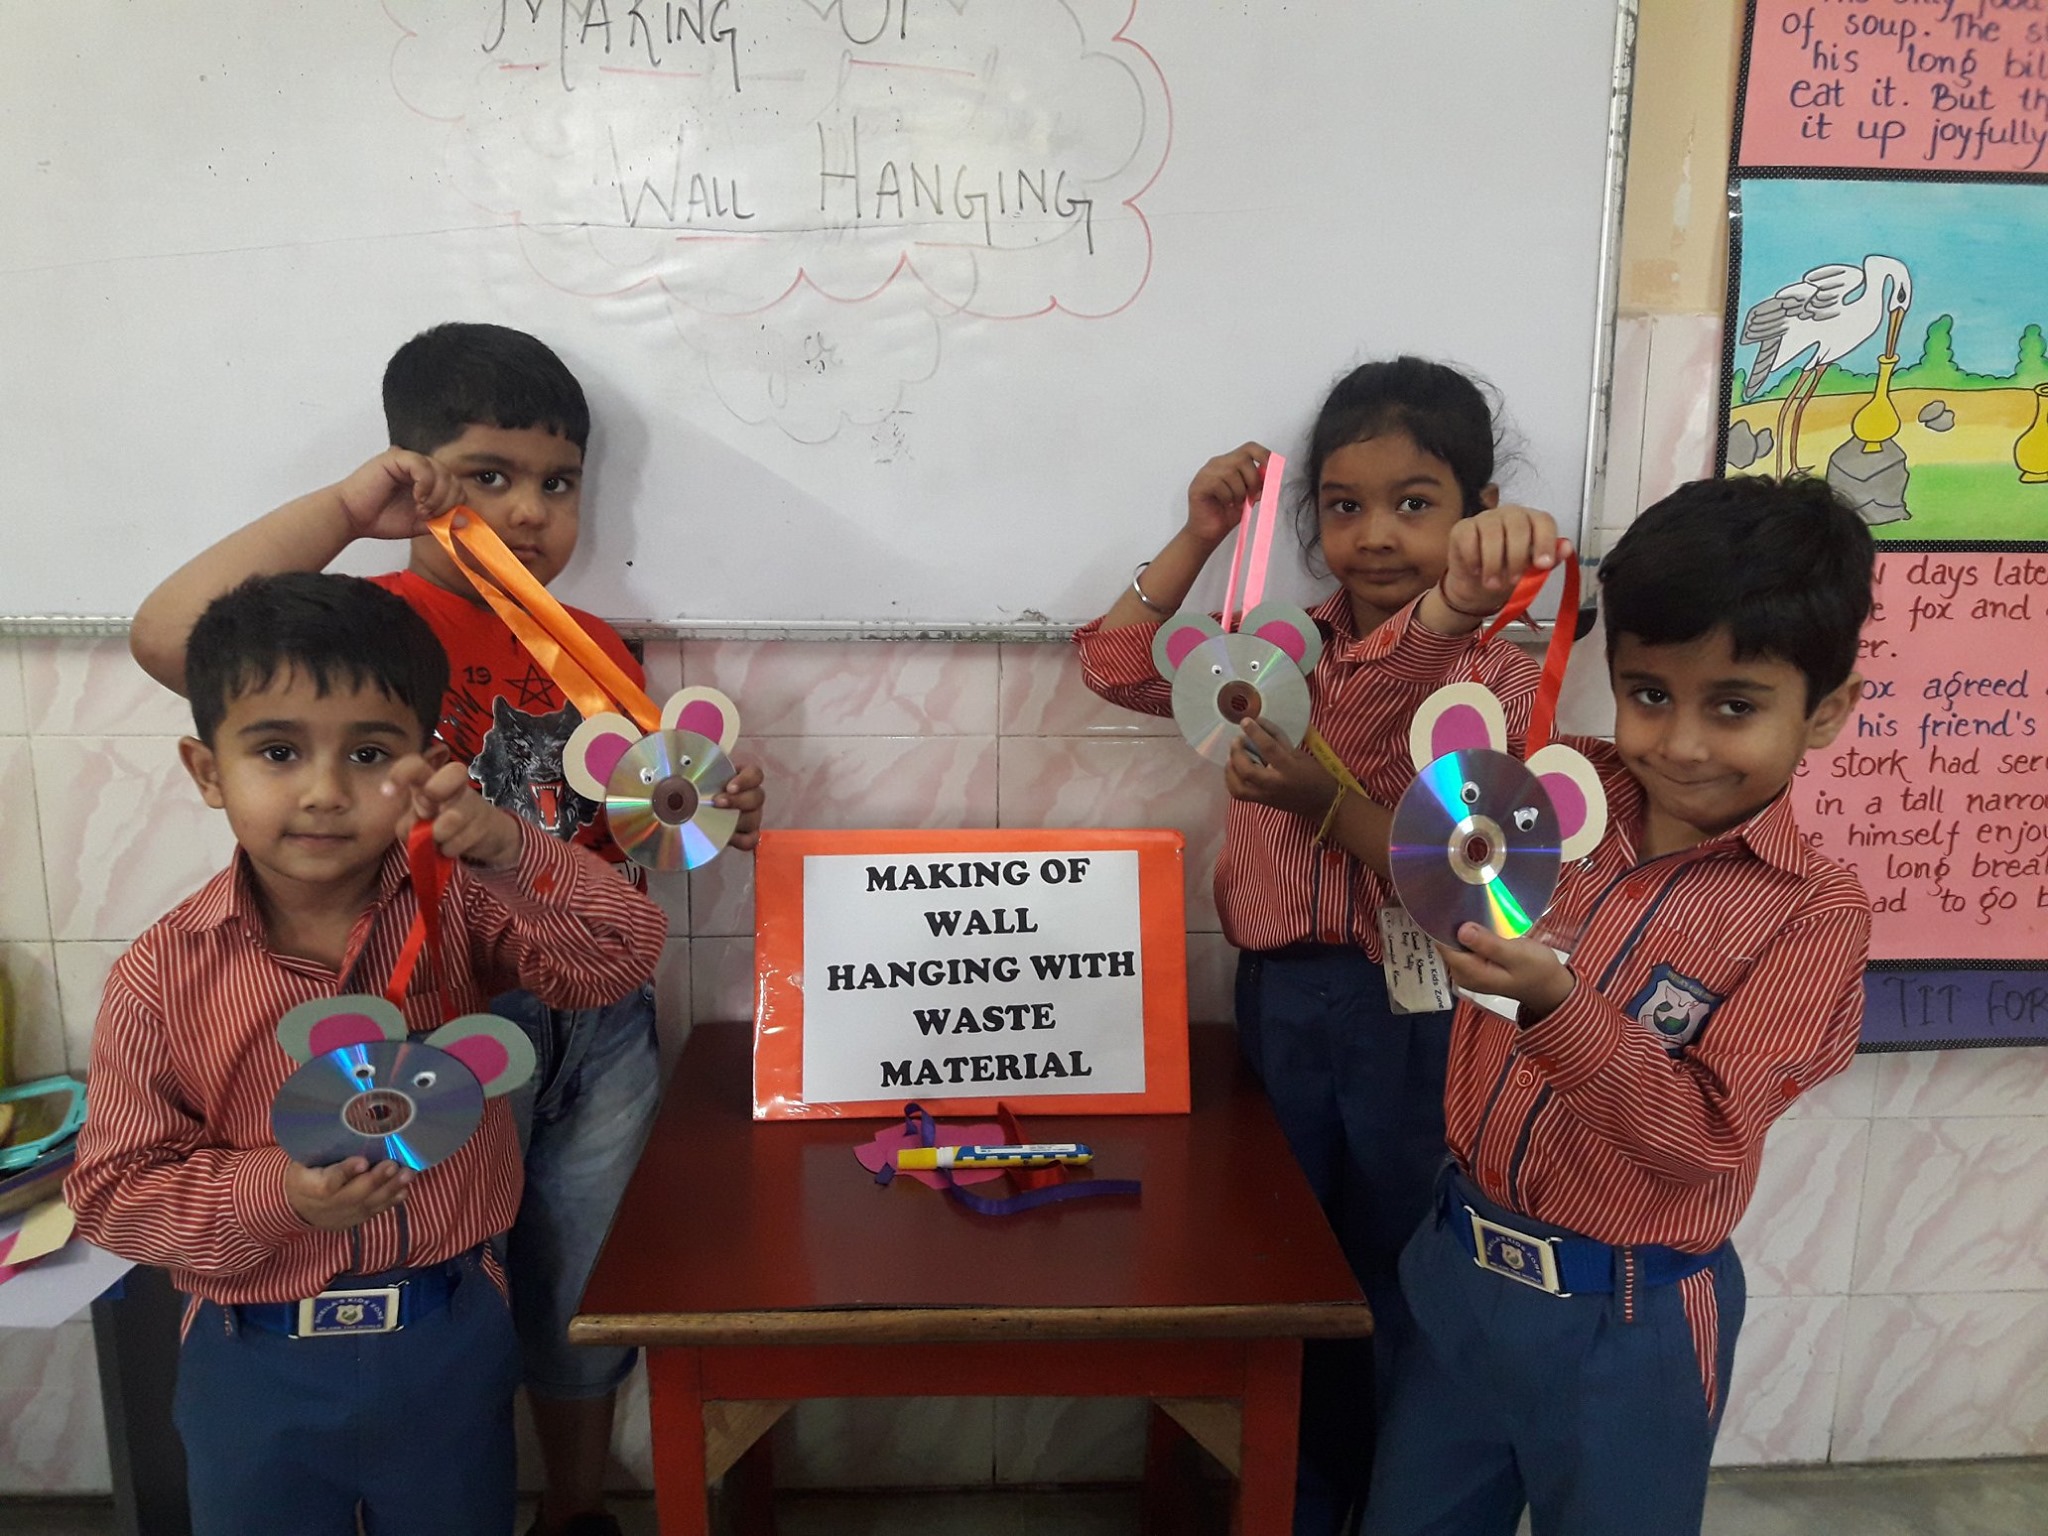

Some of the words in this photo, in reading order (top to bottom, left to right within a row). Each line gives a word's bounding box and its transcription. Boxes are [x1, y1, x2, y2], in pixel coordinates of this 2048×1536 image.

[1845, 14, 1931, 52] soup.
[1951, 13, 2001, 43] The
[1813, 40, 1859, 73] his
[1907, 43, 1977, 88] long
[2004, 47, 2048, 80] bil
[1789, 79, 1845, 108] eat
[1871, 77, 1909, 107] it.
[1931, 83, 1996, 112] But
[2017, 87, 2048, 121] th
[1801, 113, 1833, 140] it
[1858, 119, 1906, 159] up
[1923, 117, 2048, 170] joyfully
[609, 124, 755, 228] WALL
[816, 115, 1094, 255] HANGING
[1906, 554, 1978, 600] days
[1994, 556, 2048, 586] late
[1909, 595, 1954, 632] fox
[1970, 593, 2032, 620] and
[463, 666, 492, 686] 19
[1860, 679, 1897, 700] ox
[1923, 669, 2029, 712] agreed
[1857, 712, 1898, 738] his
[1918, 708, 2036, 750] friend's
[1831, 746, 1912, 783] stork
[1928, 744, 1980, 774] had
[1997, 754, 2048, 774] ser
[1815, 789, 1845, 816] in
[1864, 795, 1883, 815] a
[1900, 785, 1944, 813] tall
[1966, 792, 2048, 814] narro
[1848, 819, 1959, 856] himself
[865, 859, 1031, 892] MAKING
[1039, 857, 1091, 885] OF
[1887, 853, 1950, 896] long
[1971, 852, 2048, 879] brea
[923, 906, 1040, 938] WALL
[1871, 886, 1908, 913] ad
[1940, 888, 1967, 913] to
[1974, 886, 2018, 926] go
[826, 956, 1021, 991] HANGING
[1028, 950, 1136, 982] WITH
[912, 1002, 1057, 1037] WASTE
[1882, 975, 1963, 1029] TIT
[880, 1050, 1093, 1088] MATERIAL
